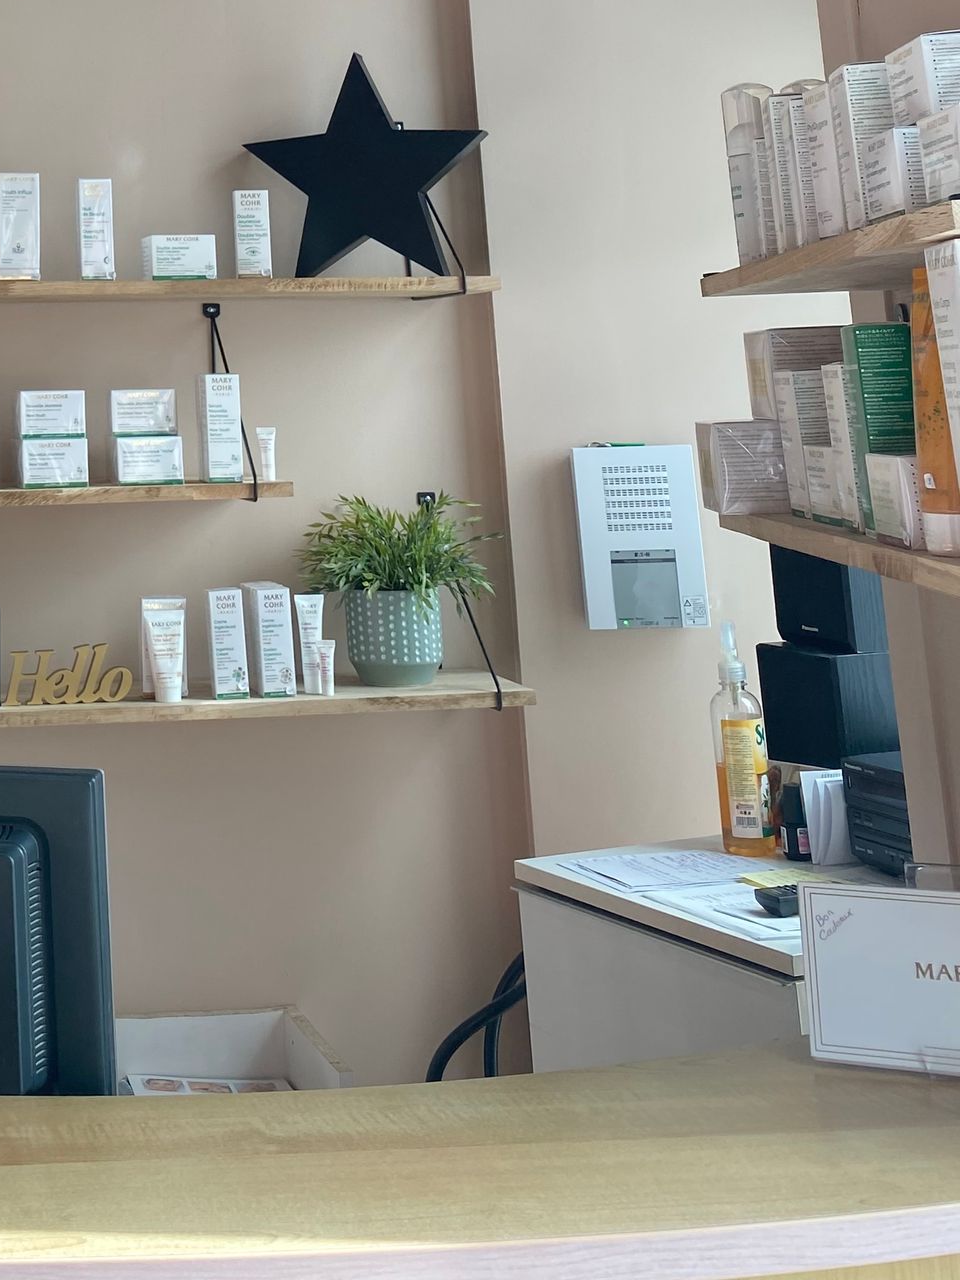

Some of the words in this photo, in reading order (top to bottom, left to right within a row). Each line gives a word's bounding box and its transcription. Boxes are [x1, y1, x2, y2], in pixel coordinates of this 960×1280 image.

[216, 602, 237, 610] COHR
[2, 643, 133, 706] Hello
[815, 910, 835, 928] Bon
